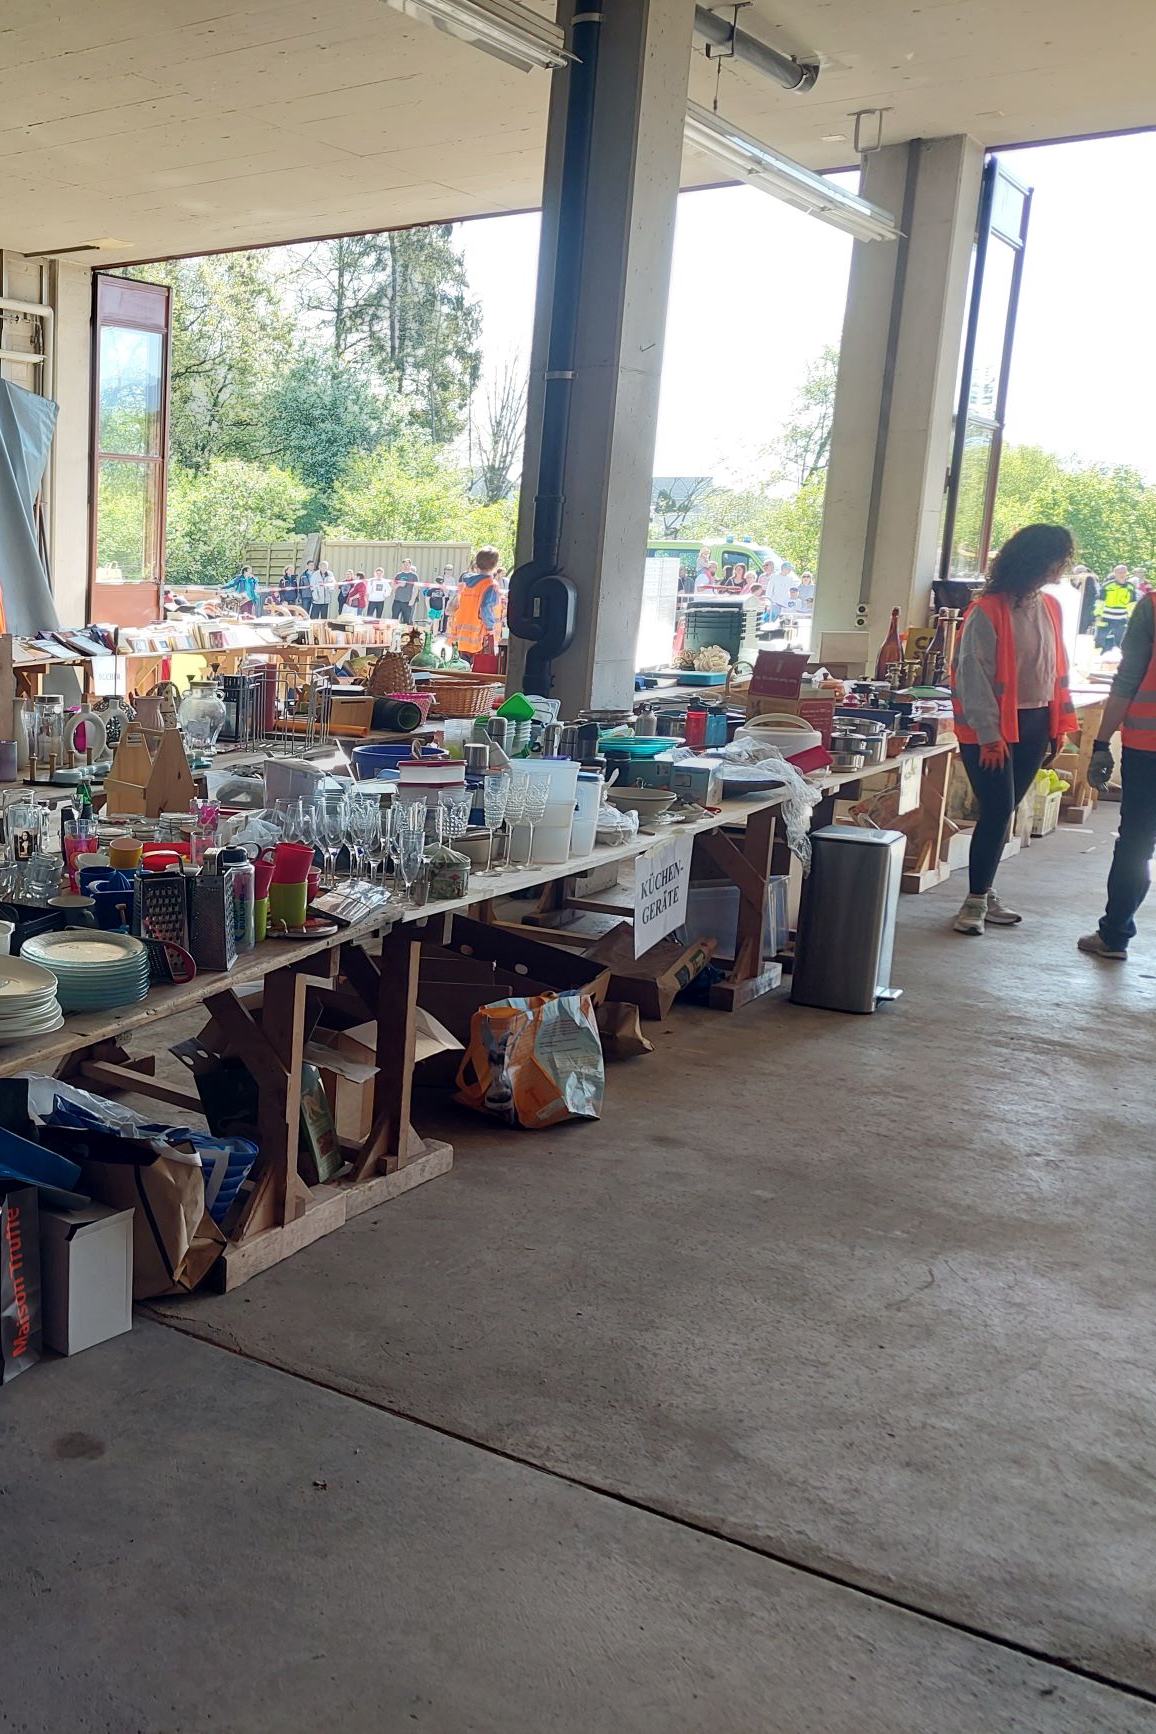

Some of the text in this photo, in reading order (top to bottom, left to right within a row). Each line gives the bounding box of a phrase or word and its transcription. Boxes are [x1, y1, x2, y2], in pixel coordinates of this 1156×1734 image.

[641, 860, 684, 900] KÜCHEN-
[642, 886, 680, 925] GERÄTE
[12, 1279, 31, 1358] Maison
